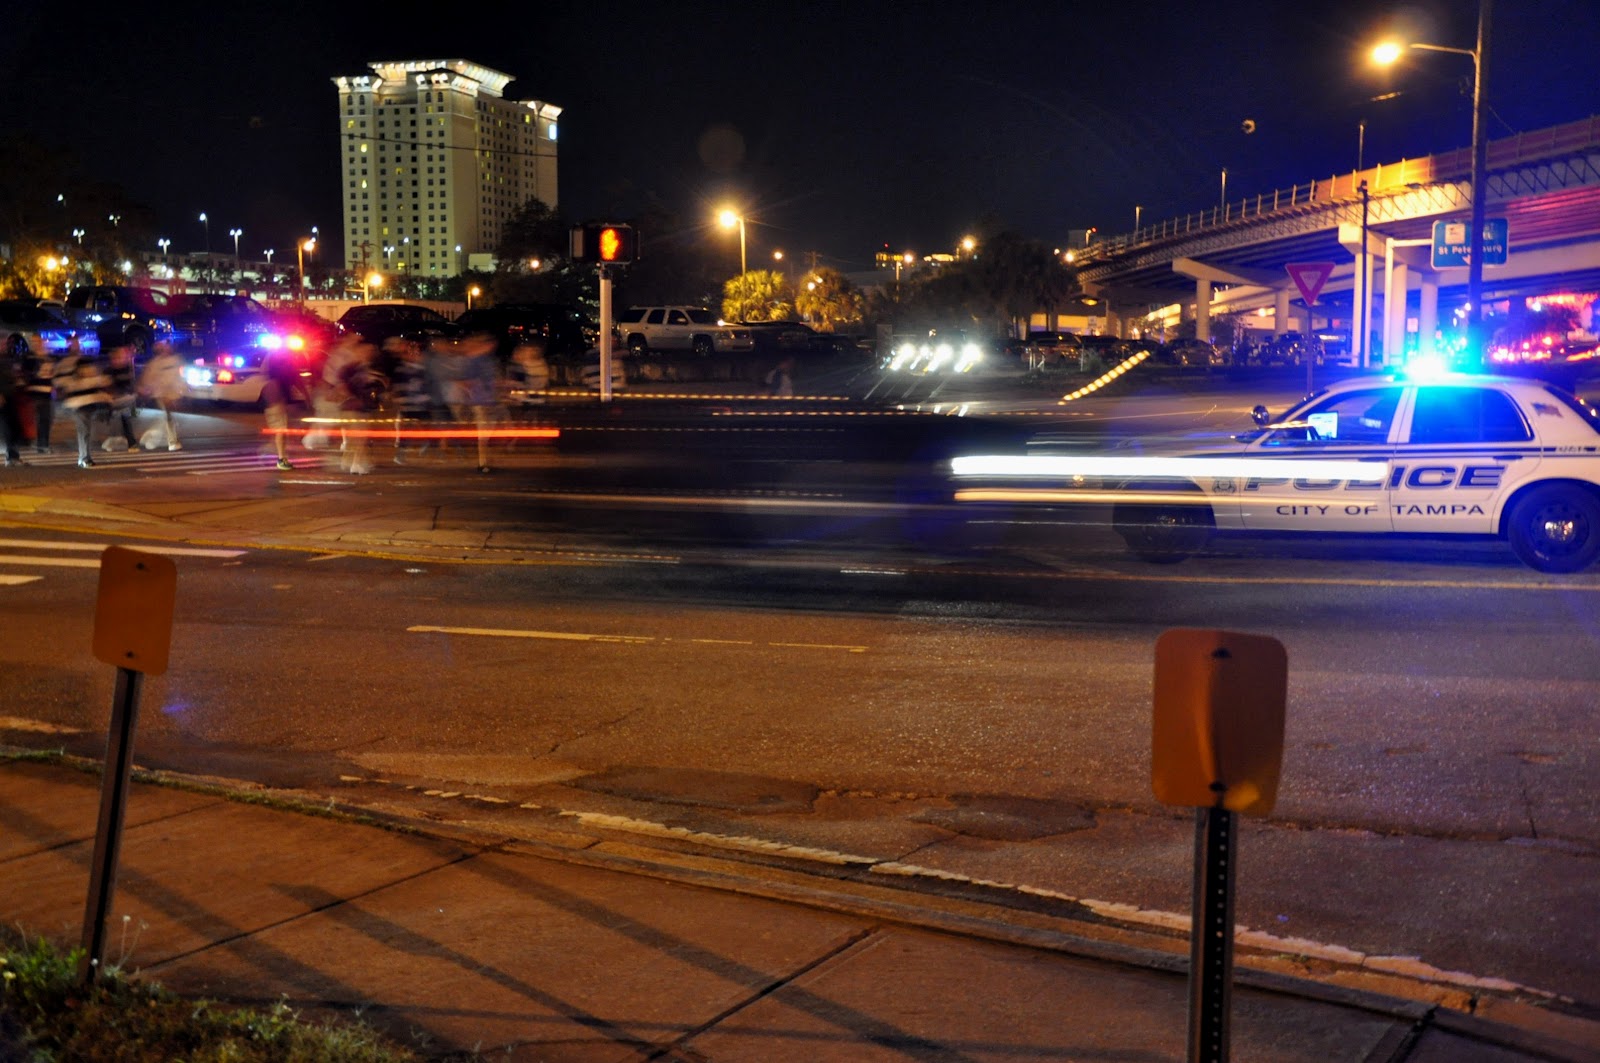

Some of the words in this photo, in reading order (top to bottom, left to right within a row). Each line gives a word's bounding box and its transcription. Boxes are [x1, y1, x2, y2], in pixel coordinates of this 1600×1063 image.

[1452, 244, 1503, 254] Peteurg
[1276, 505, 1330, 515] CITY
[1344, 505, 1378, 515] OF
[1392, 504, 1485, 515] TAMPA
